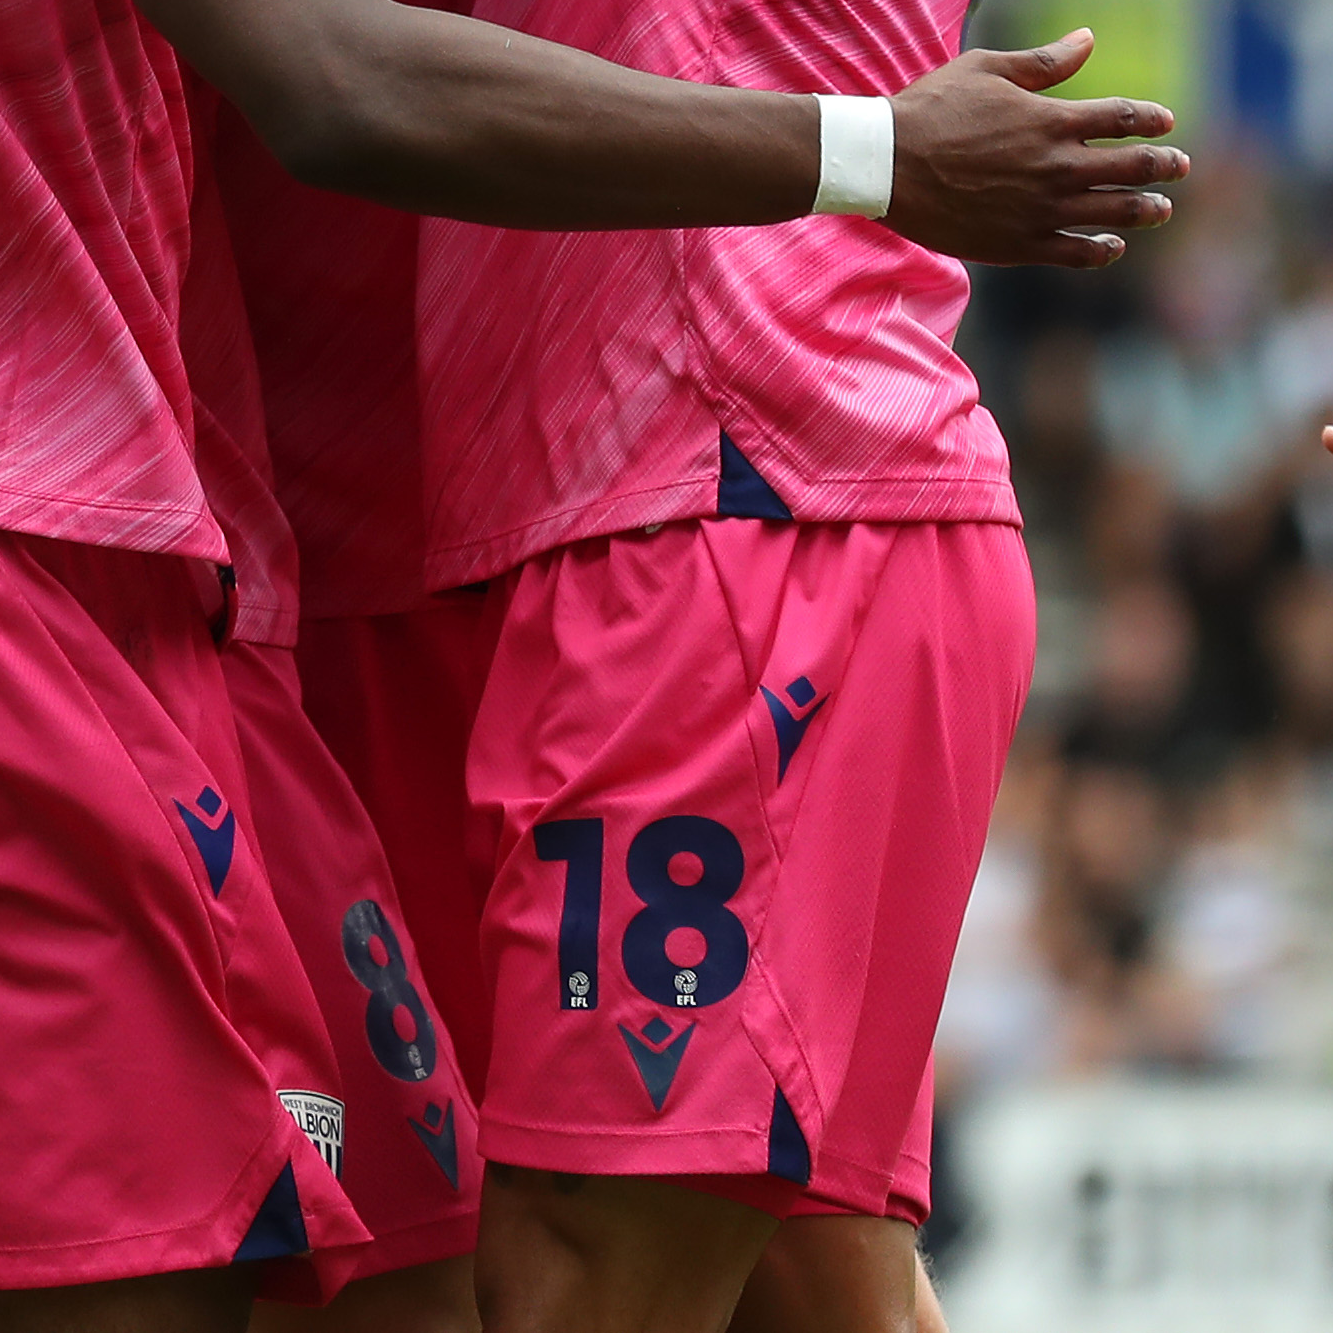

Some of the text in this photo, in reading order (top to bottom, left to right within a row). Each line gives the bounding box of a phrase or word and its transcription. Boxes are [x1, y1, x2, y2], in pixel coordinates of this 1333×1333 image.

[533, 814, 749, 1010] 18
[341, 898, 437, 1082] 8
[570, 996, 589, 1008] EFL
[676, 994, 697, 1006] EFL
